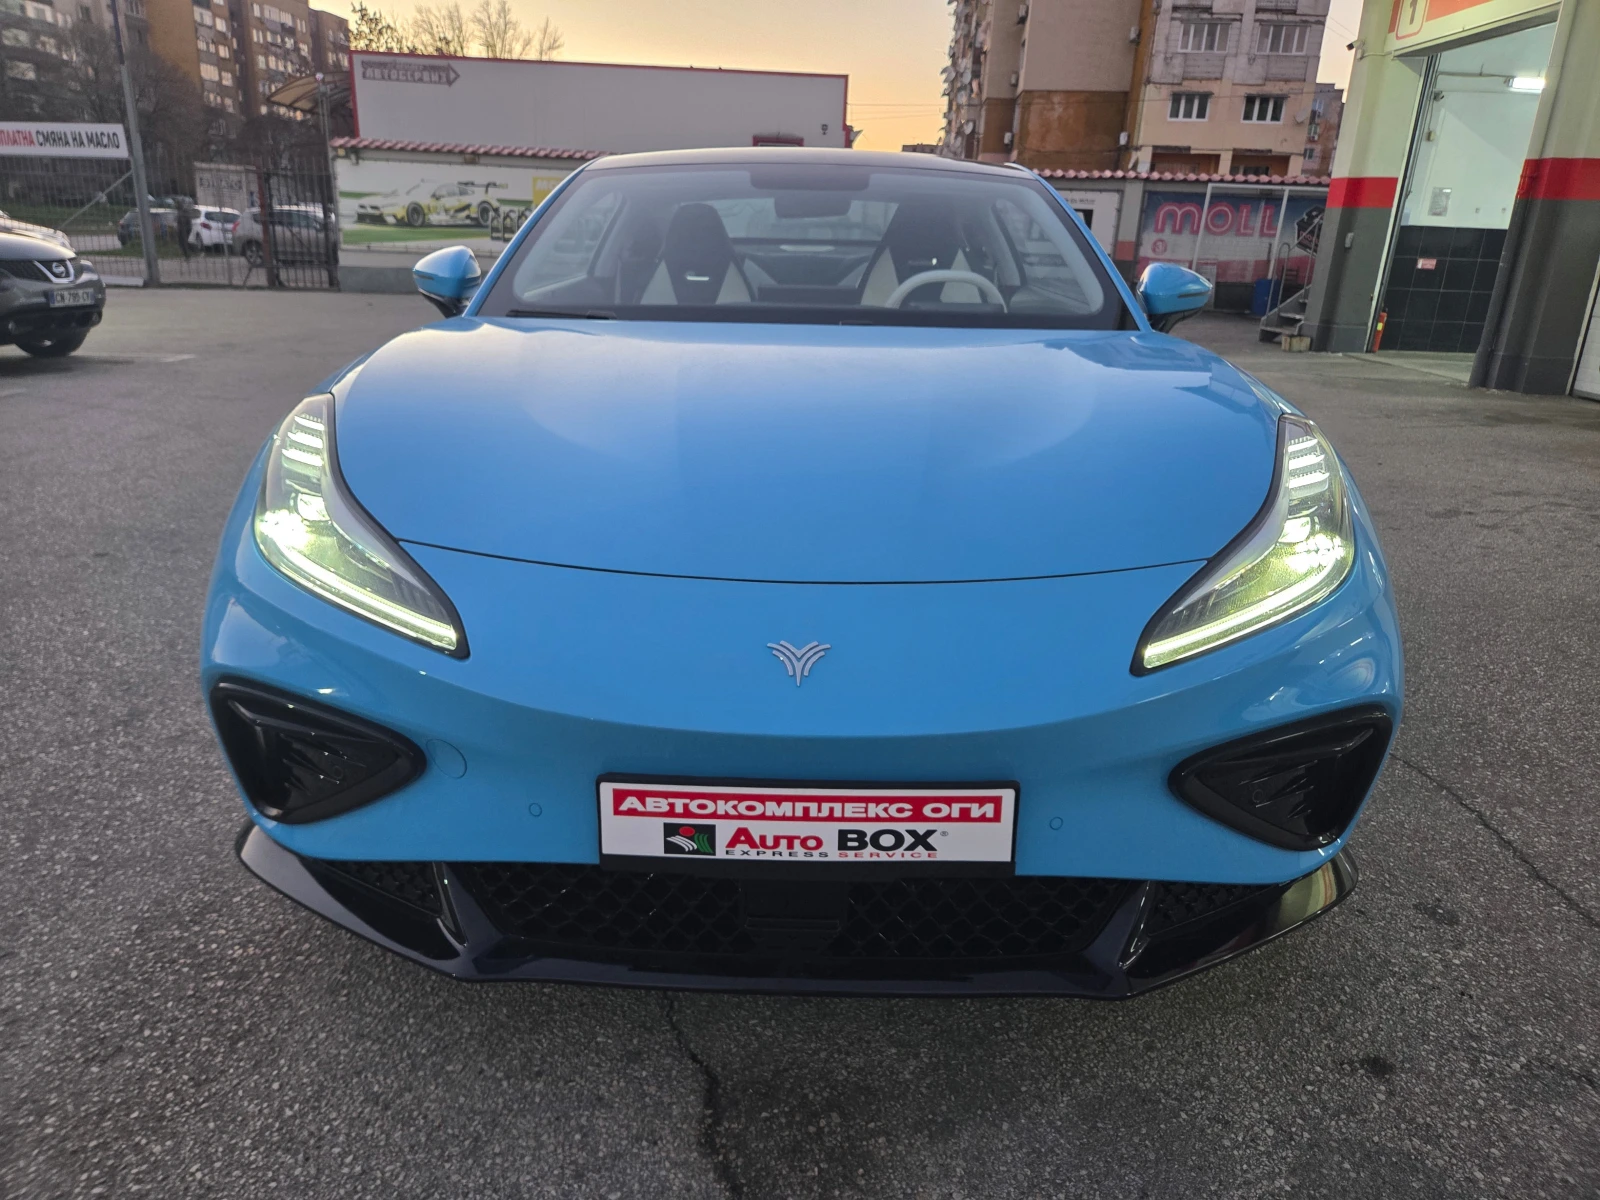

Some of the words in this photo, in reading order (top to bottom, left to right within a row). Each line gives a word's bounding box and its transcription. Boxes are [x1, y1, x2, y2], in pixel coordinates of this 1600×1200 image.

[36, 130, 70, 148] СМЯНА
[70, 131, 85, 148] НА
[85, 132, 120, 148] МАСЛО
[618, 796, 914, 818] АВТОКОМПЛЕКС
[922, 803, 995, 818] ОГИ
[725, 849, 829, 858] EXPRESS
